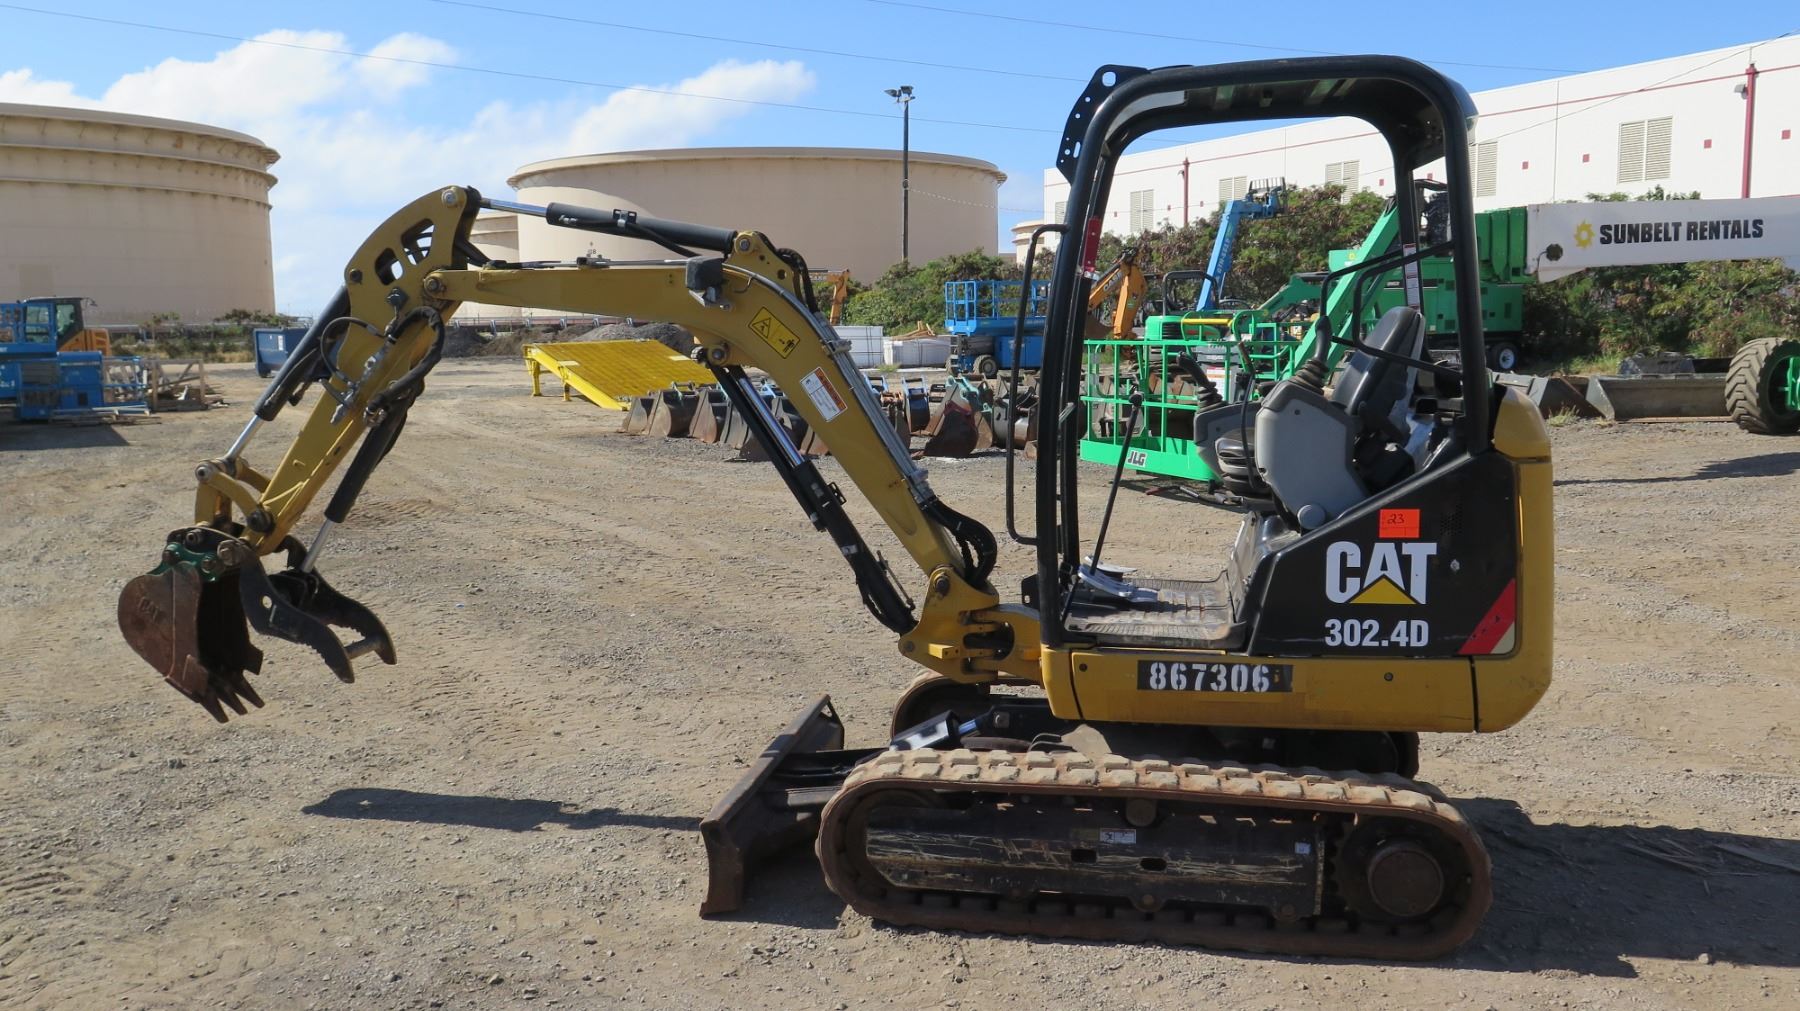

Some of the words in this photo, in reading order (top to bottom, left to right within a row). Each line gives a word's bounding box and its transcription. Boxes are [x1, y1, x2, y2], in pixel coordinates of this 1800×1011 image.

[1600, 222, 1682, 245] SUNBELT
[1686, 219, 1764, 241] RENTALS
[1127, 451, 1146, 466] JLG
[1387, 513, 1405, 525] 23
[1325, 541, 1437, 605] CAT
[1324, 618, 1429, 647] 302.4D
[1149, 661, 1270, 693] 867306
